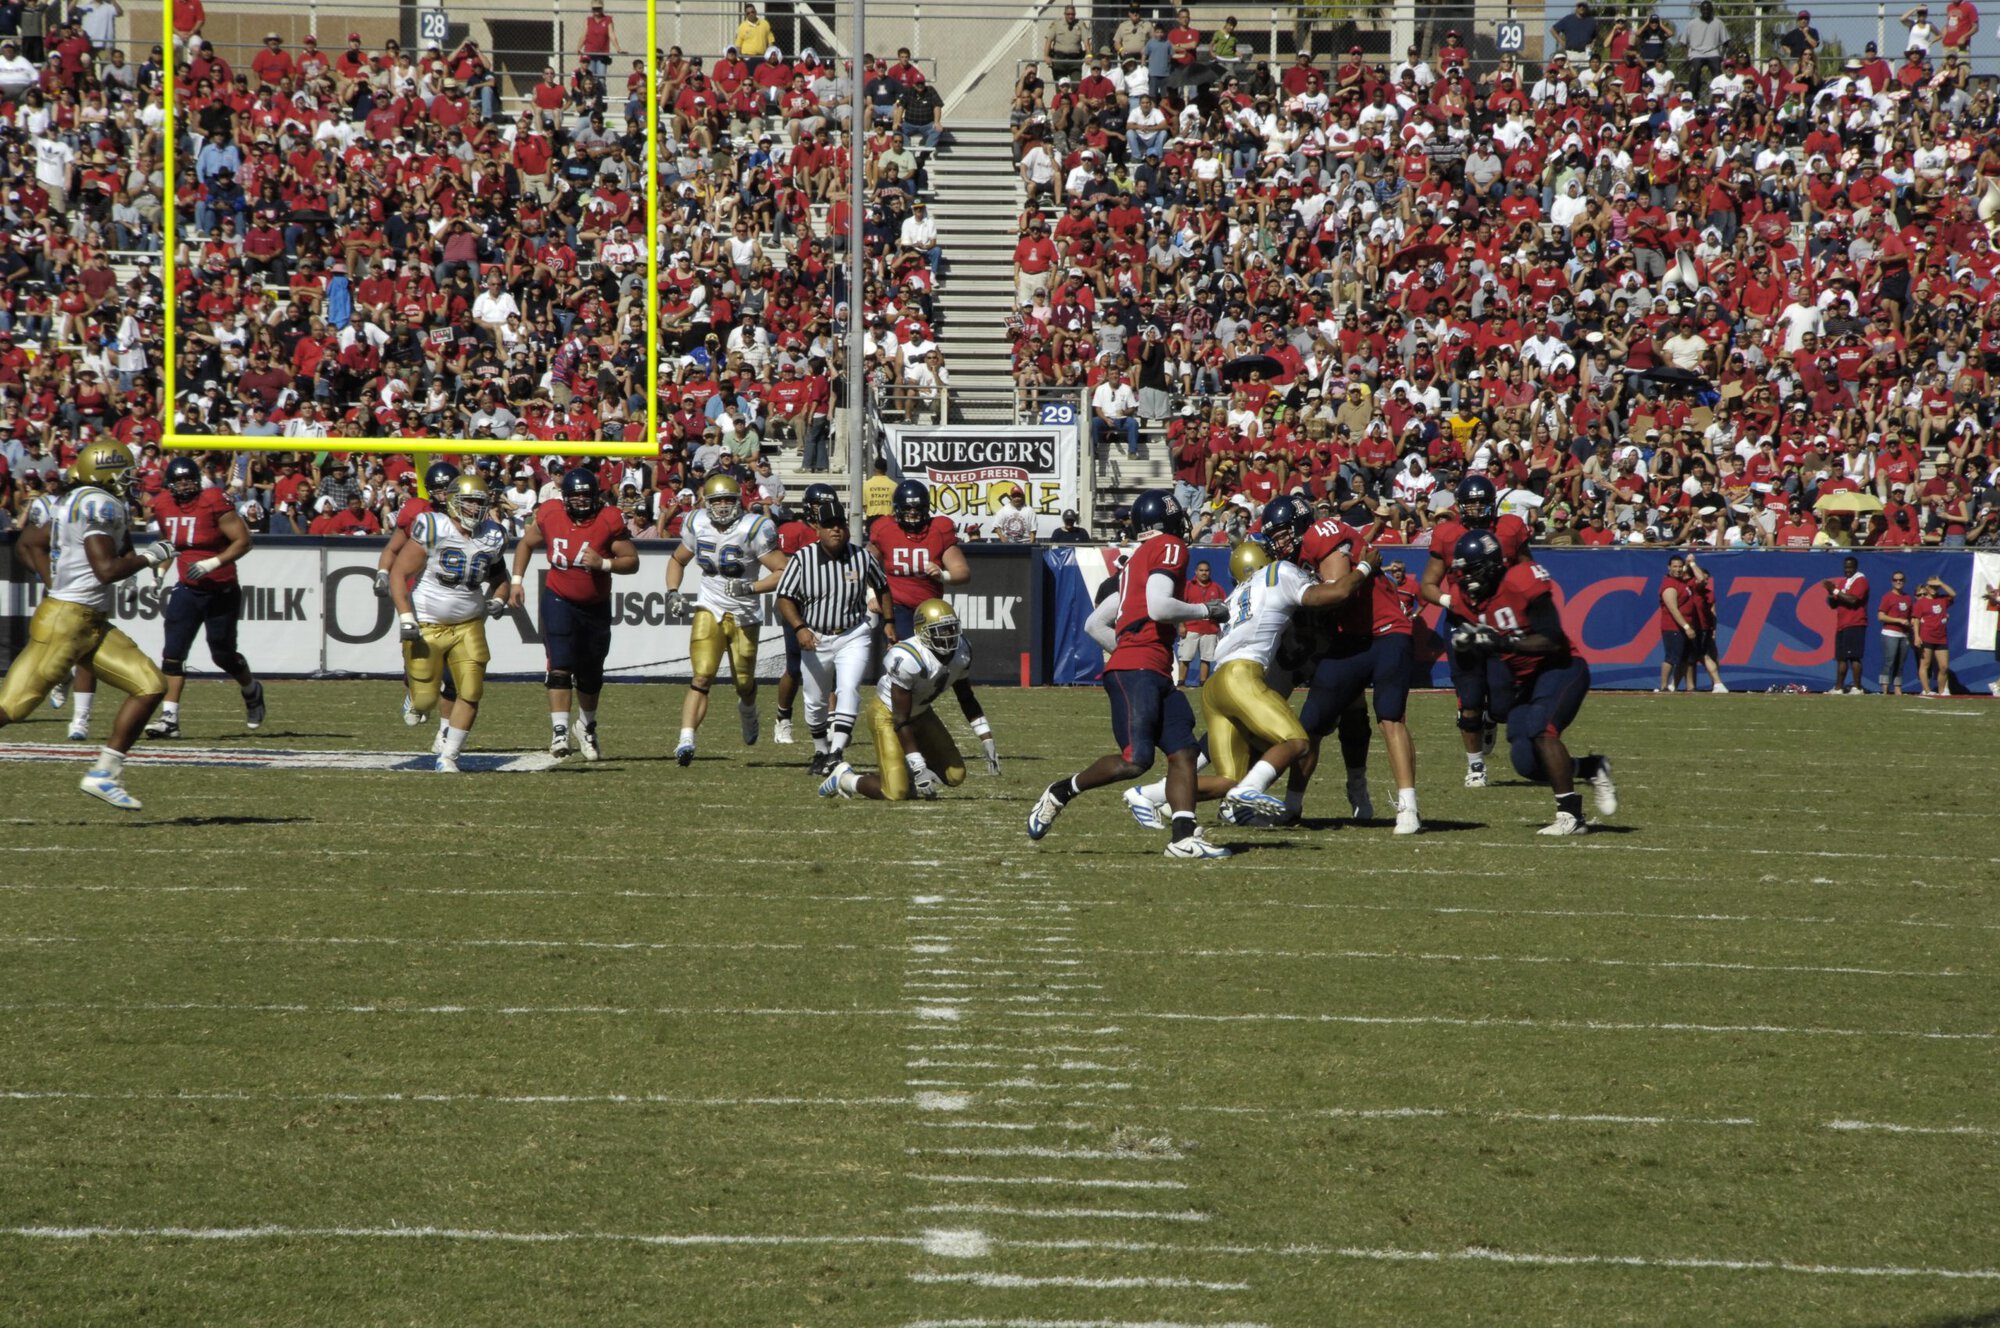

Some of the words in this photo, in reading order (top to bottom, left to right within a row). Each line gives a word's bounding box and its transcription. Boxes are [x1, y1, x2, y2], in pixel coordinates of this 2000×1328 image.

[424, 14, 446, 38] 28
[1500, 25, 1522, 49] 29
[1044, 405, 1073, 423] 29
[903, 440, 1054, 468] BRUEGGER'S
[935, 471, 976, 483] BAKED
[980, 469, 1018, 479] FRESH
[165, 516, 197, 547] 77
[1315, 520, 1340, 538] 48
[551, 537, 590, 574] 64
[697, 540, 746, 578] 56
[892, 547, 930, 577] 50
[1162, 543, 1180, 565] 11
[437, 546, 490, 591] 90
